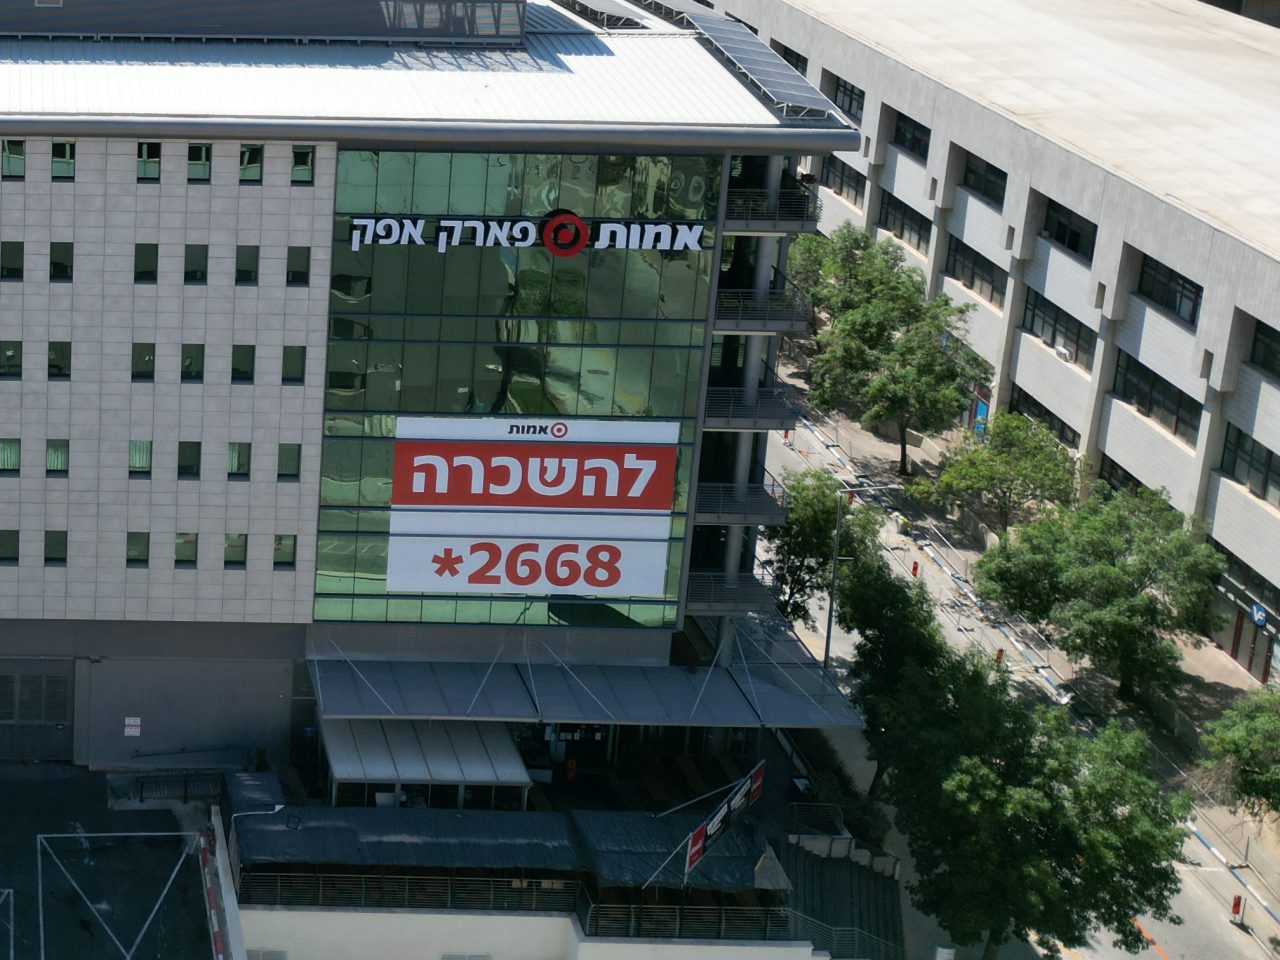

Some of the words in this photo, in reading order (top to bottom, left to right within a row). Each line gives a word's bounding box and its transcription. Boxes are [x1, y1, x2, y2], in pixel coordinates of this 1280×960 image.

[350, 218, 426, 252] אפק
[437, 220, 537, 253] פארק
[594, 223, 703, 251] אמות
[508, 424, 549, 436] אמות
[412, 453, 657, 498] להשכרה
